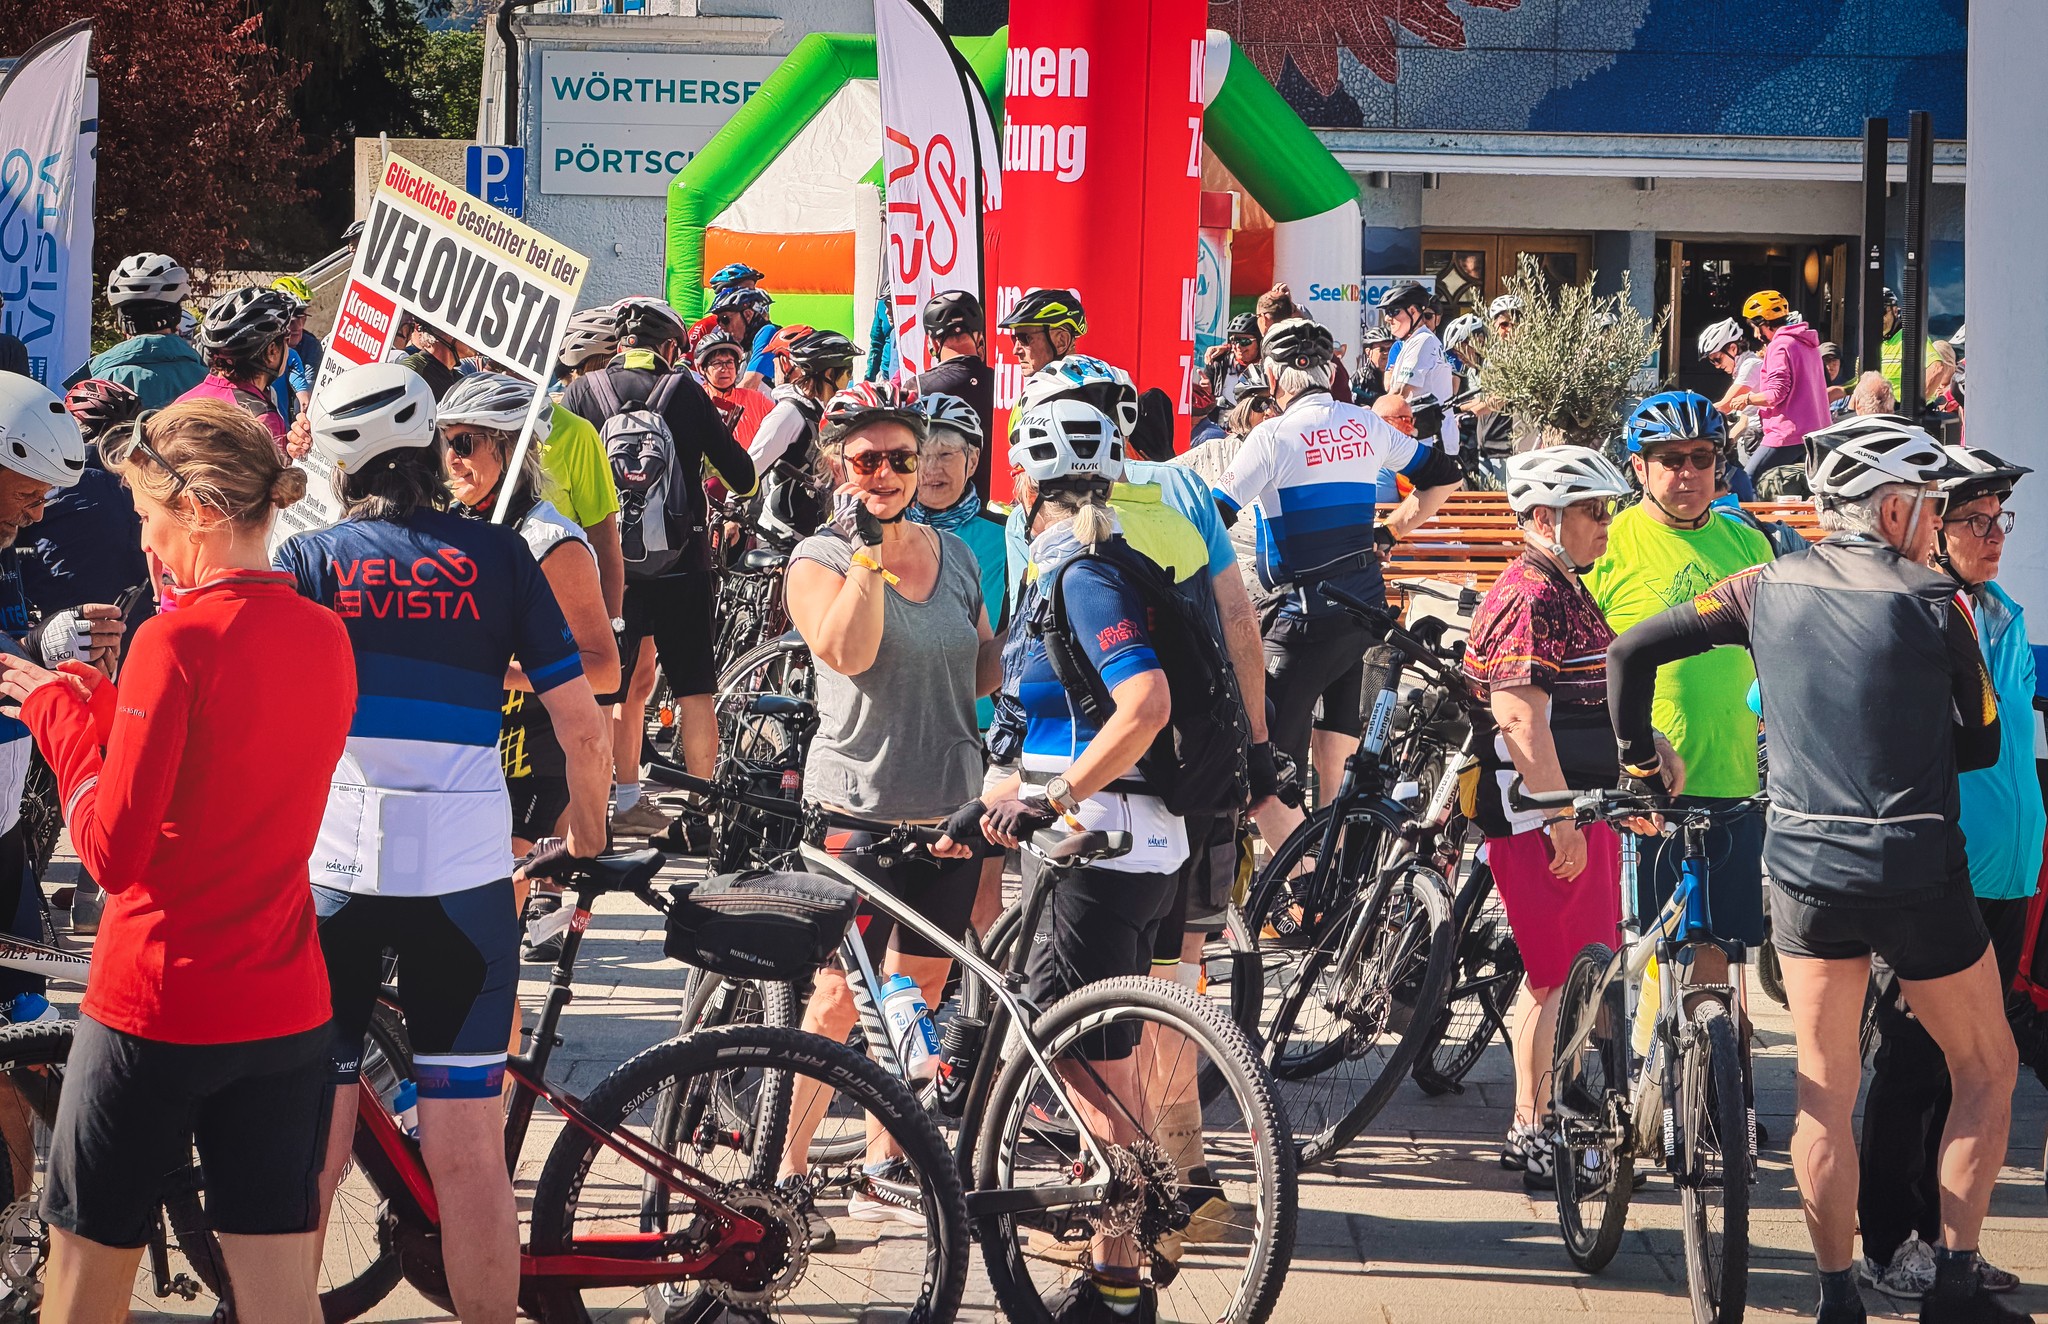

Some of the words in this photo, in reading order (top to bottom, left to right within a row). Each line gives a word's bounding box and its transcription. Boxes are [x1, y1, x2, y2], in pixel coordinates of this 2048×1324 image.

[385, 161, 457, 221] Glückliche
[456, 201, 528, 258] Gesichter
[525, 238, 555, 273] bei
[550, 254, 581, 286] der
[362, 199, 561, 377] VELOVISTA
[345, 289, 390, 333] Kronen
[338, 316, 382, 360] Zeitung
[1071, 462, 1099, 471] KASK
[1322, 441, 1375, 463] VISTA
[1853, 450, 1880, 464] ALPINA
[332, 548, 478, 587] VELO
[365, 591, 481, 620] VISTA
[1108, 629, 1142, 646] VISTA
[1376, 705, 1392, 740] benger
[757, 957, 776, 968] KAUL
[657, 1074, 677, 1090] DT
[831, 1065, 903, 1119] RACING
[621, 1086, 655, 1115] SWISS
[1663, 1108, 1675, 1157] ROCKSHOX
[1746, 1107, 1758, 1156] ROCKSHOX
